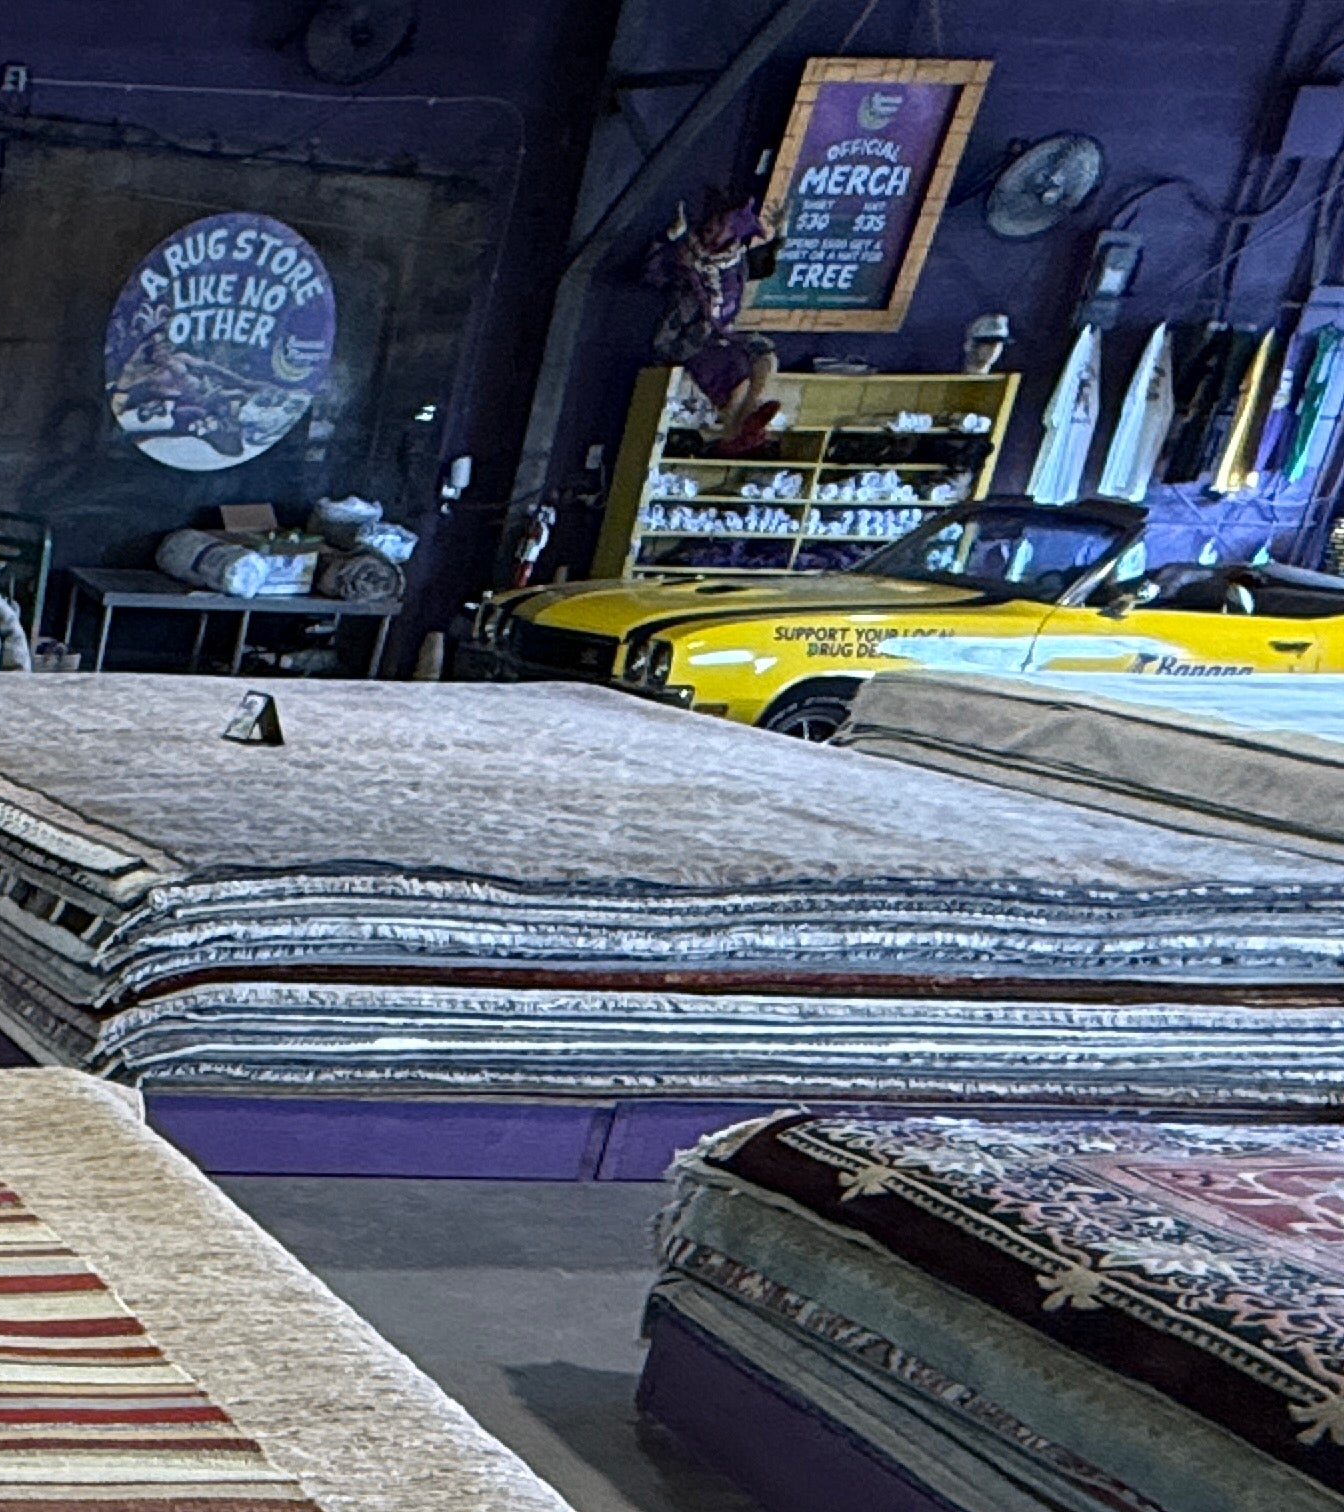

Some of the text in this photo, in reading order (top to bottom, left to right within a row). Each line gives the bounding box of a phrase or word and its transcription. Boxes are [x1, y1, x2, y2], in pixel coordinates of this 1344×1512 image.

[827, 138, 901, 162] OFFICIAL
[799, 165, 911, 195] MERCH
[140, 228, 324, 306] A RUG STORE
[787, 263, 859, 289] FREE
[172, 273, 287, 313] LIKE NO
[168, 308, 276, 348] OTHER
[774, 627, 851, 641] SUPPORT
[855, 628, 898, 642] YOUR
[807, 643, 853, 657] DRUG
